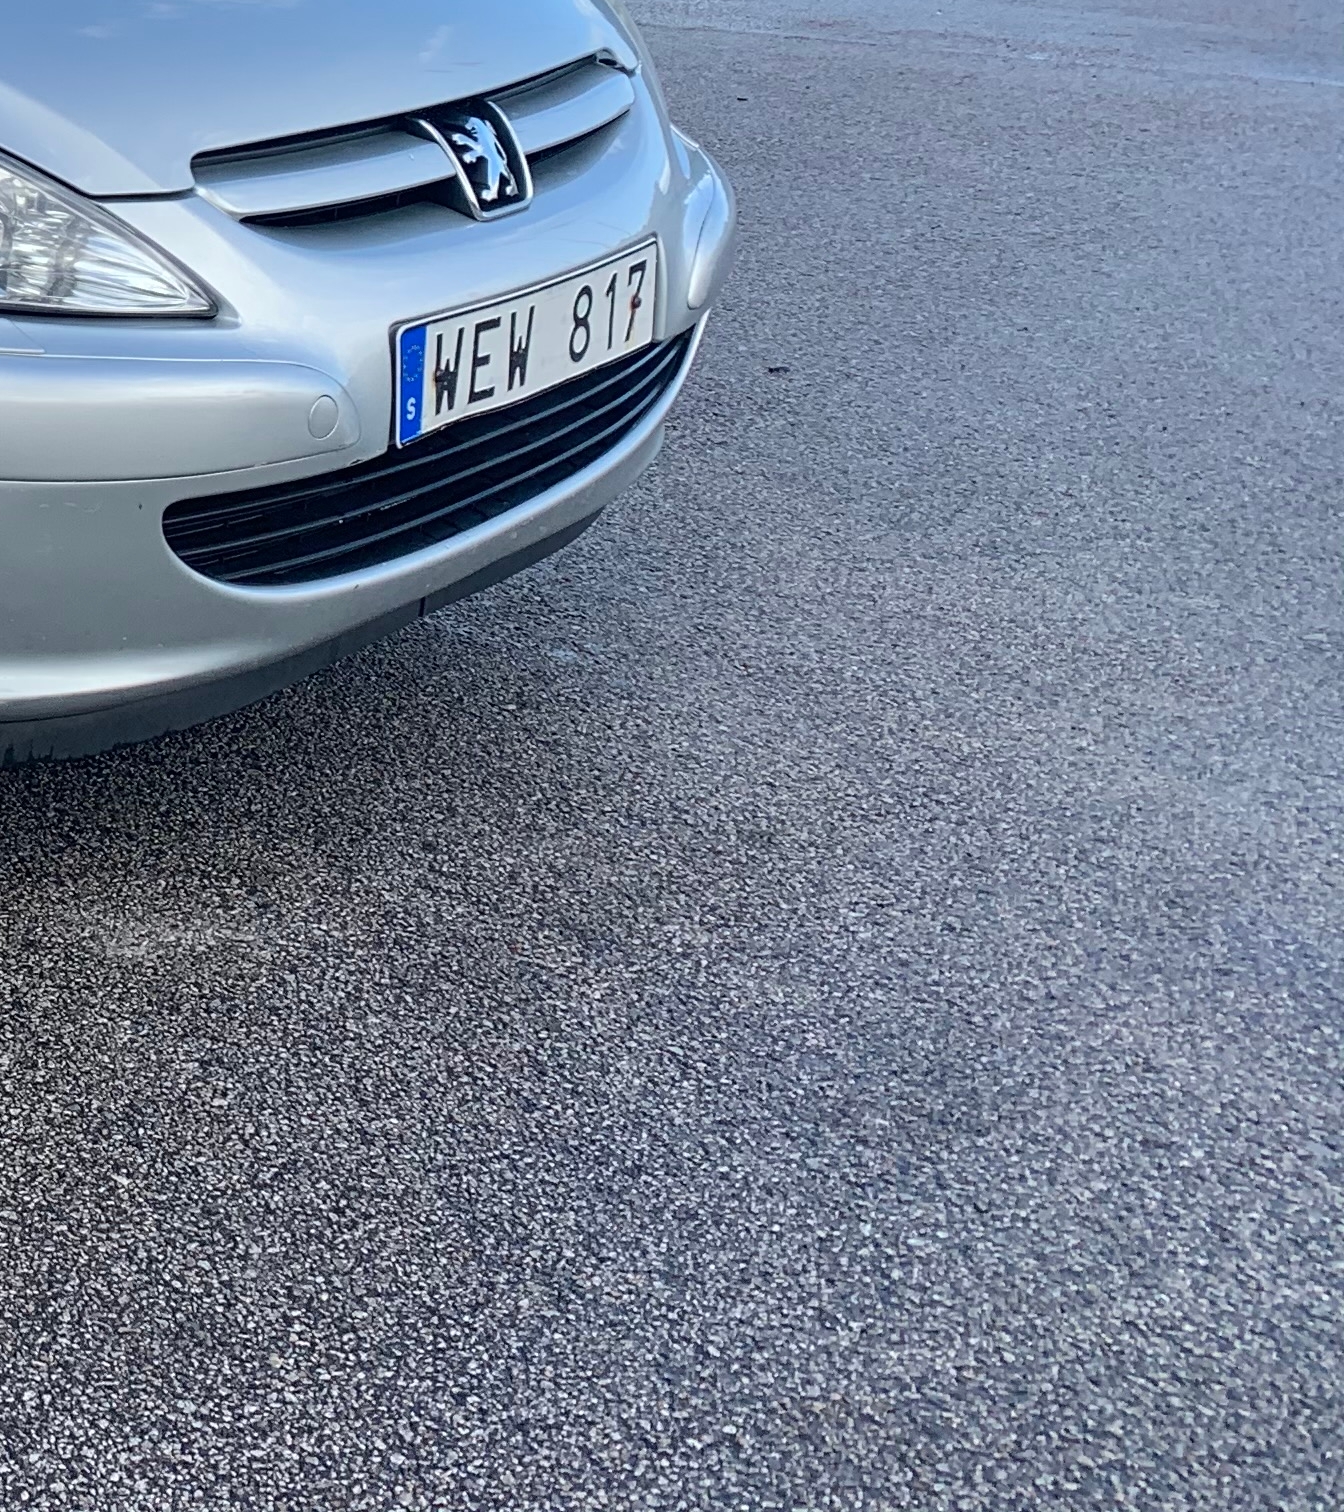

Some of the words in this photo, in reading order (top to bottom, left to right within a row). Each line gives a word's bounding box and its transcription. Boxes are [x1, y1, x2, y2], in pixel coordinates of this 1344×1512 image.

[434, 304, 535, 416] WEW
[569, 259, 647, 363] 817
[406, 396, 417, 420] S
